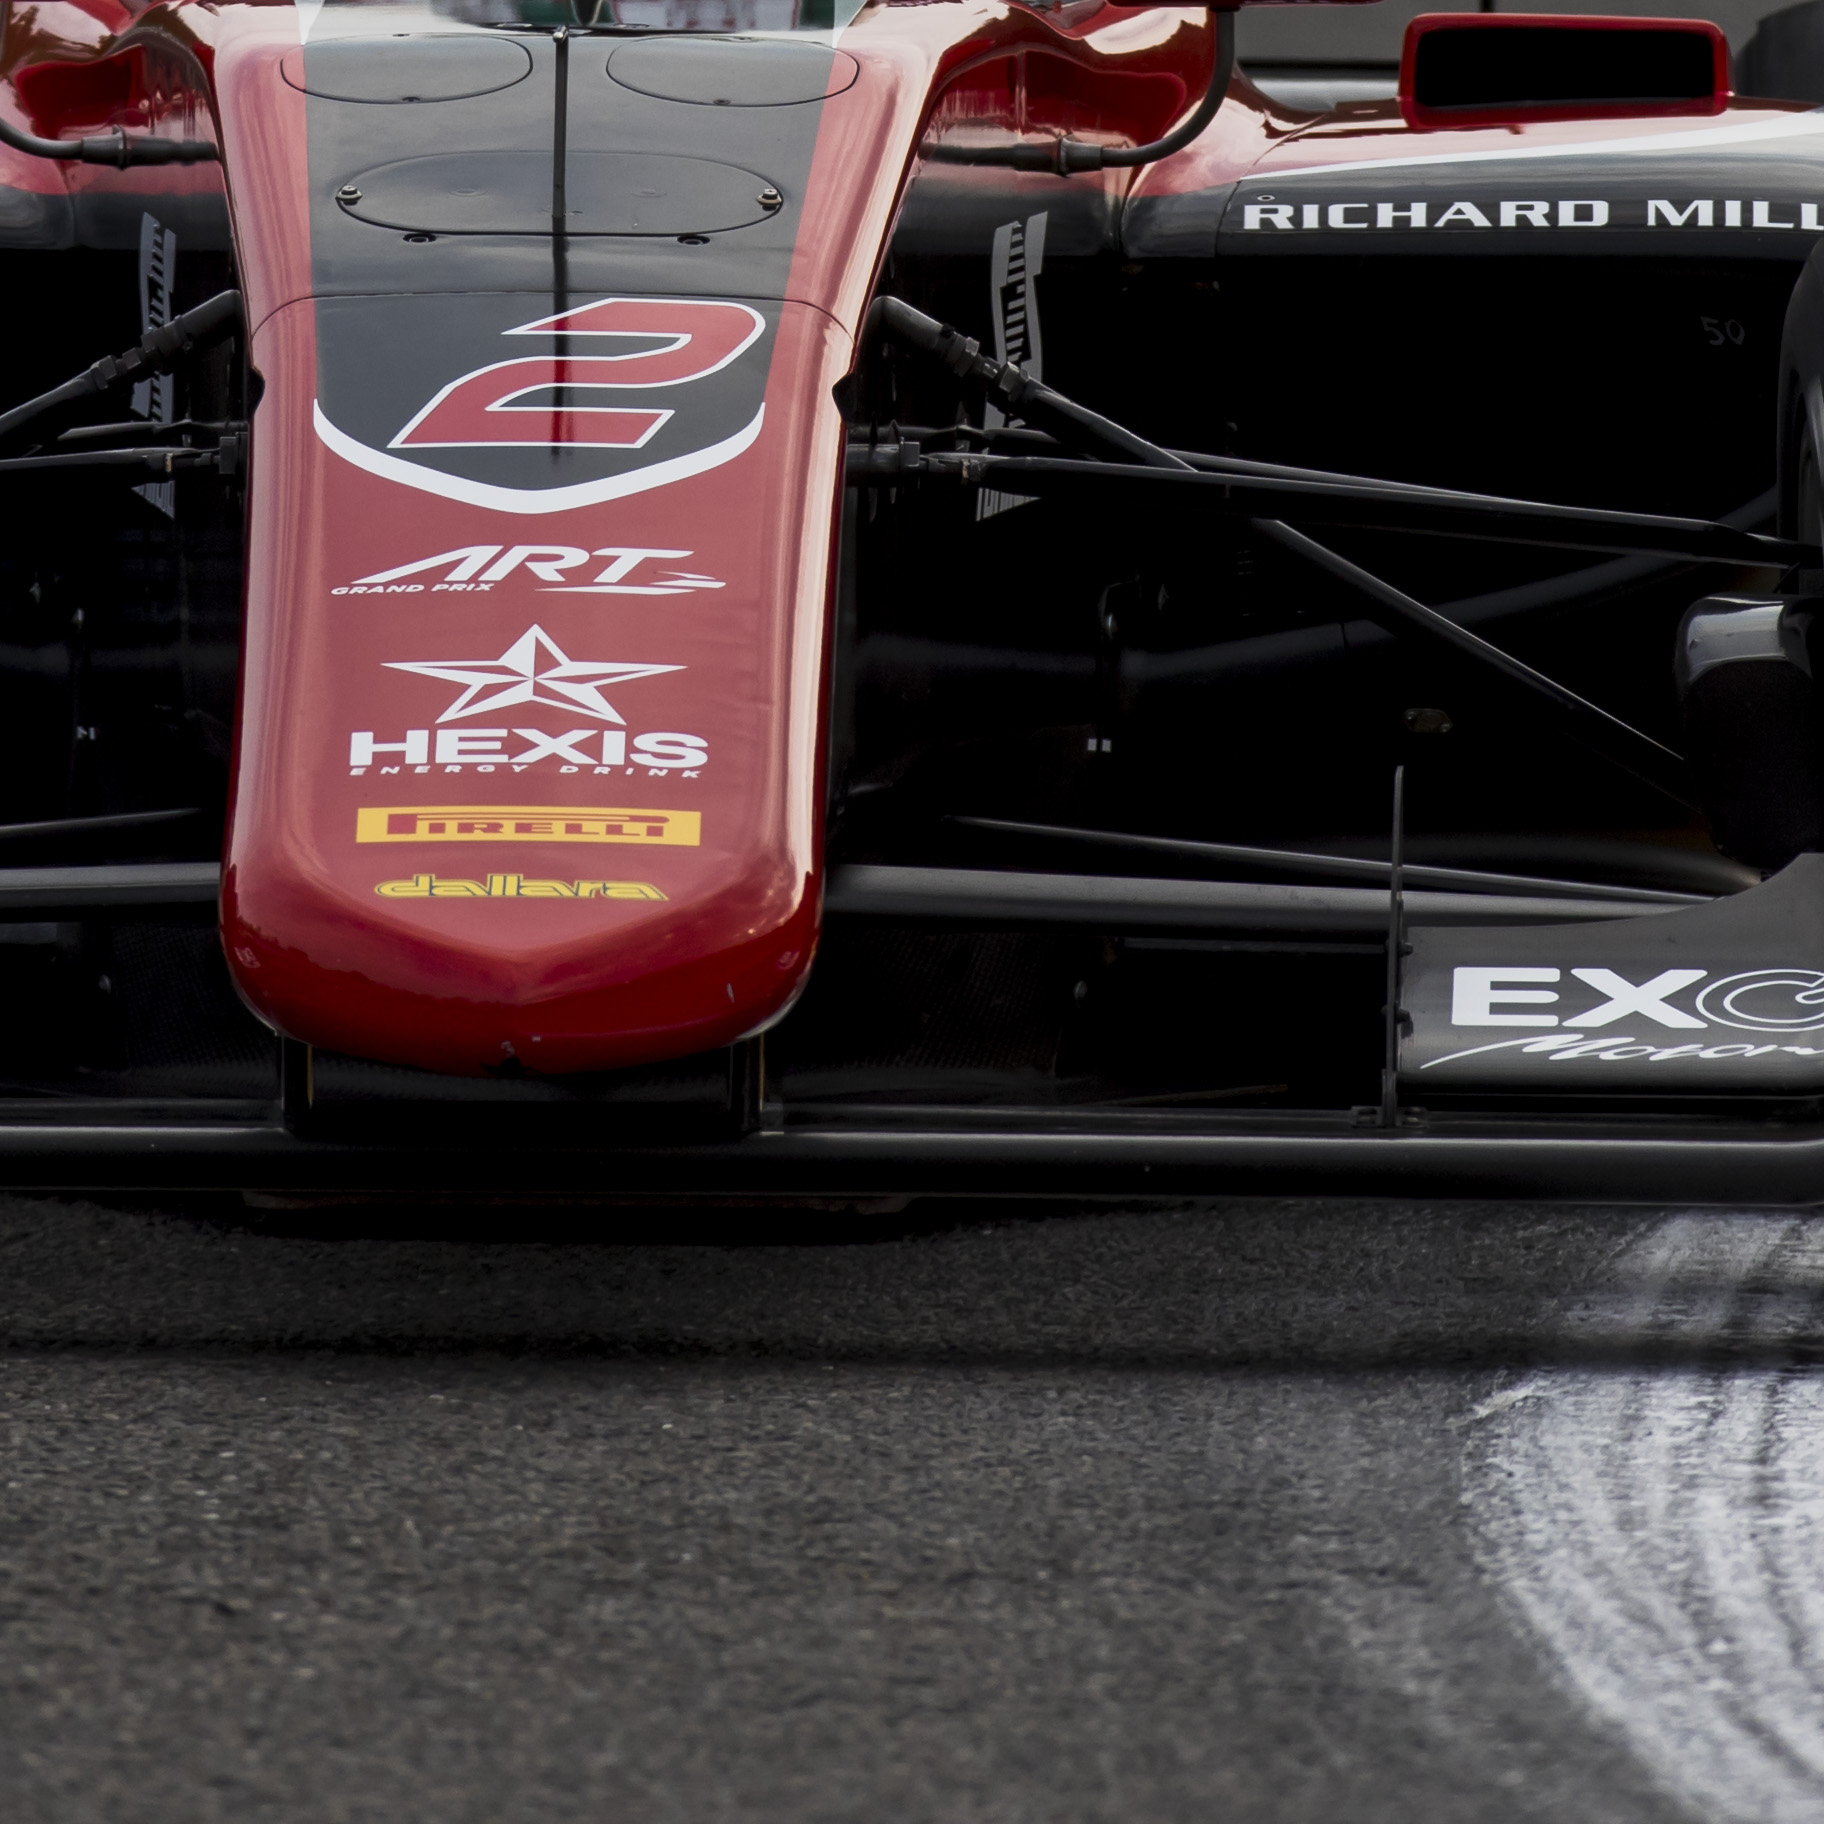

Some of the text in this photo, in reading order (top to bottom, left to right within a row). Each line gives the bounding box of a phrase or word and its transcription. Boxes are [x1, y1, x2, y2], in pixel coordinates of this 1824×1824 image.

[1242, 199, 1609, 230] RICHARD
[387, 297, 767, 449] 2
[349, 544, 700, 585] ART
[330, 582, 495, 597] GRAND PRIX
[349, 728, 709, 769] HEXIS
[349, 764, 702, 778] ENERGY DRINK
[386, 812, 670, 838] PIRELLI
[374, 873, 670, 901] dallara
